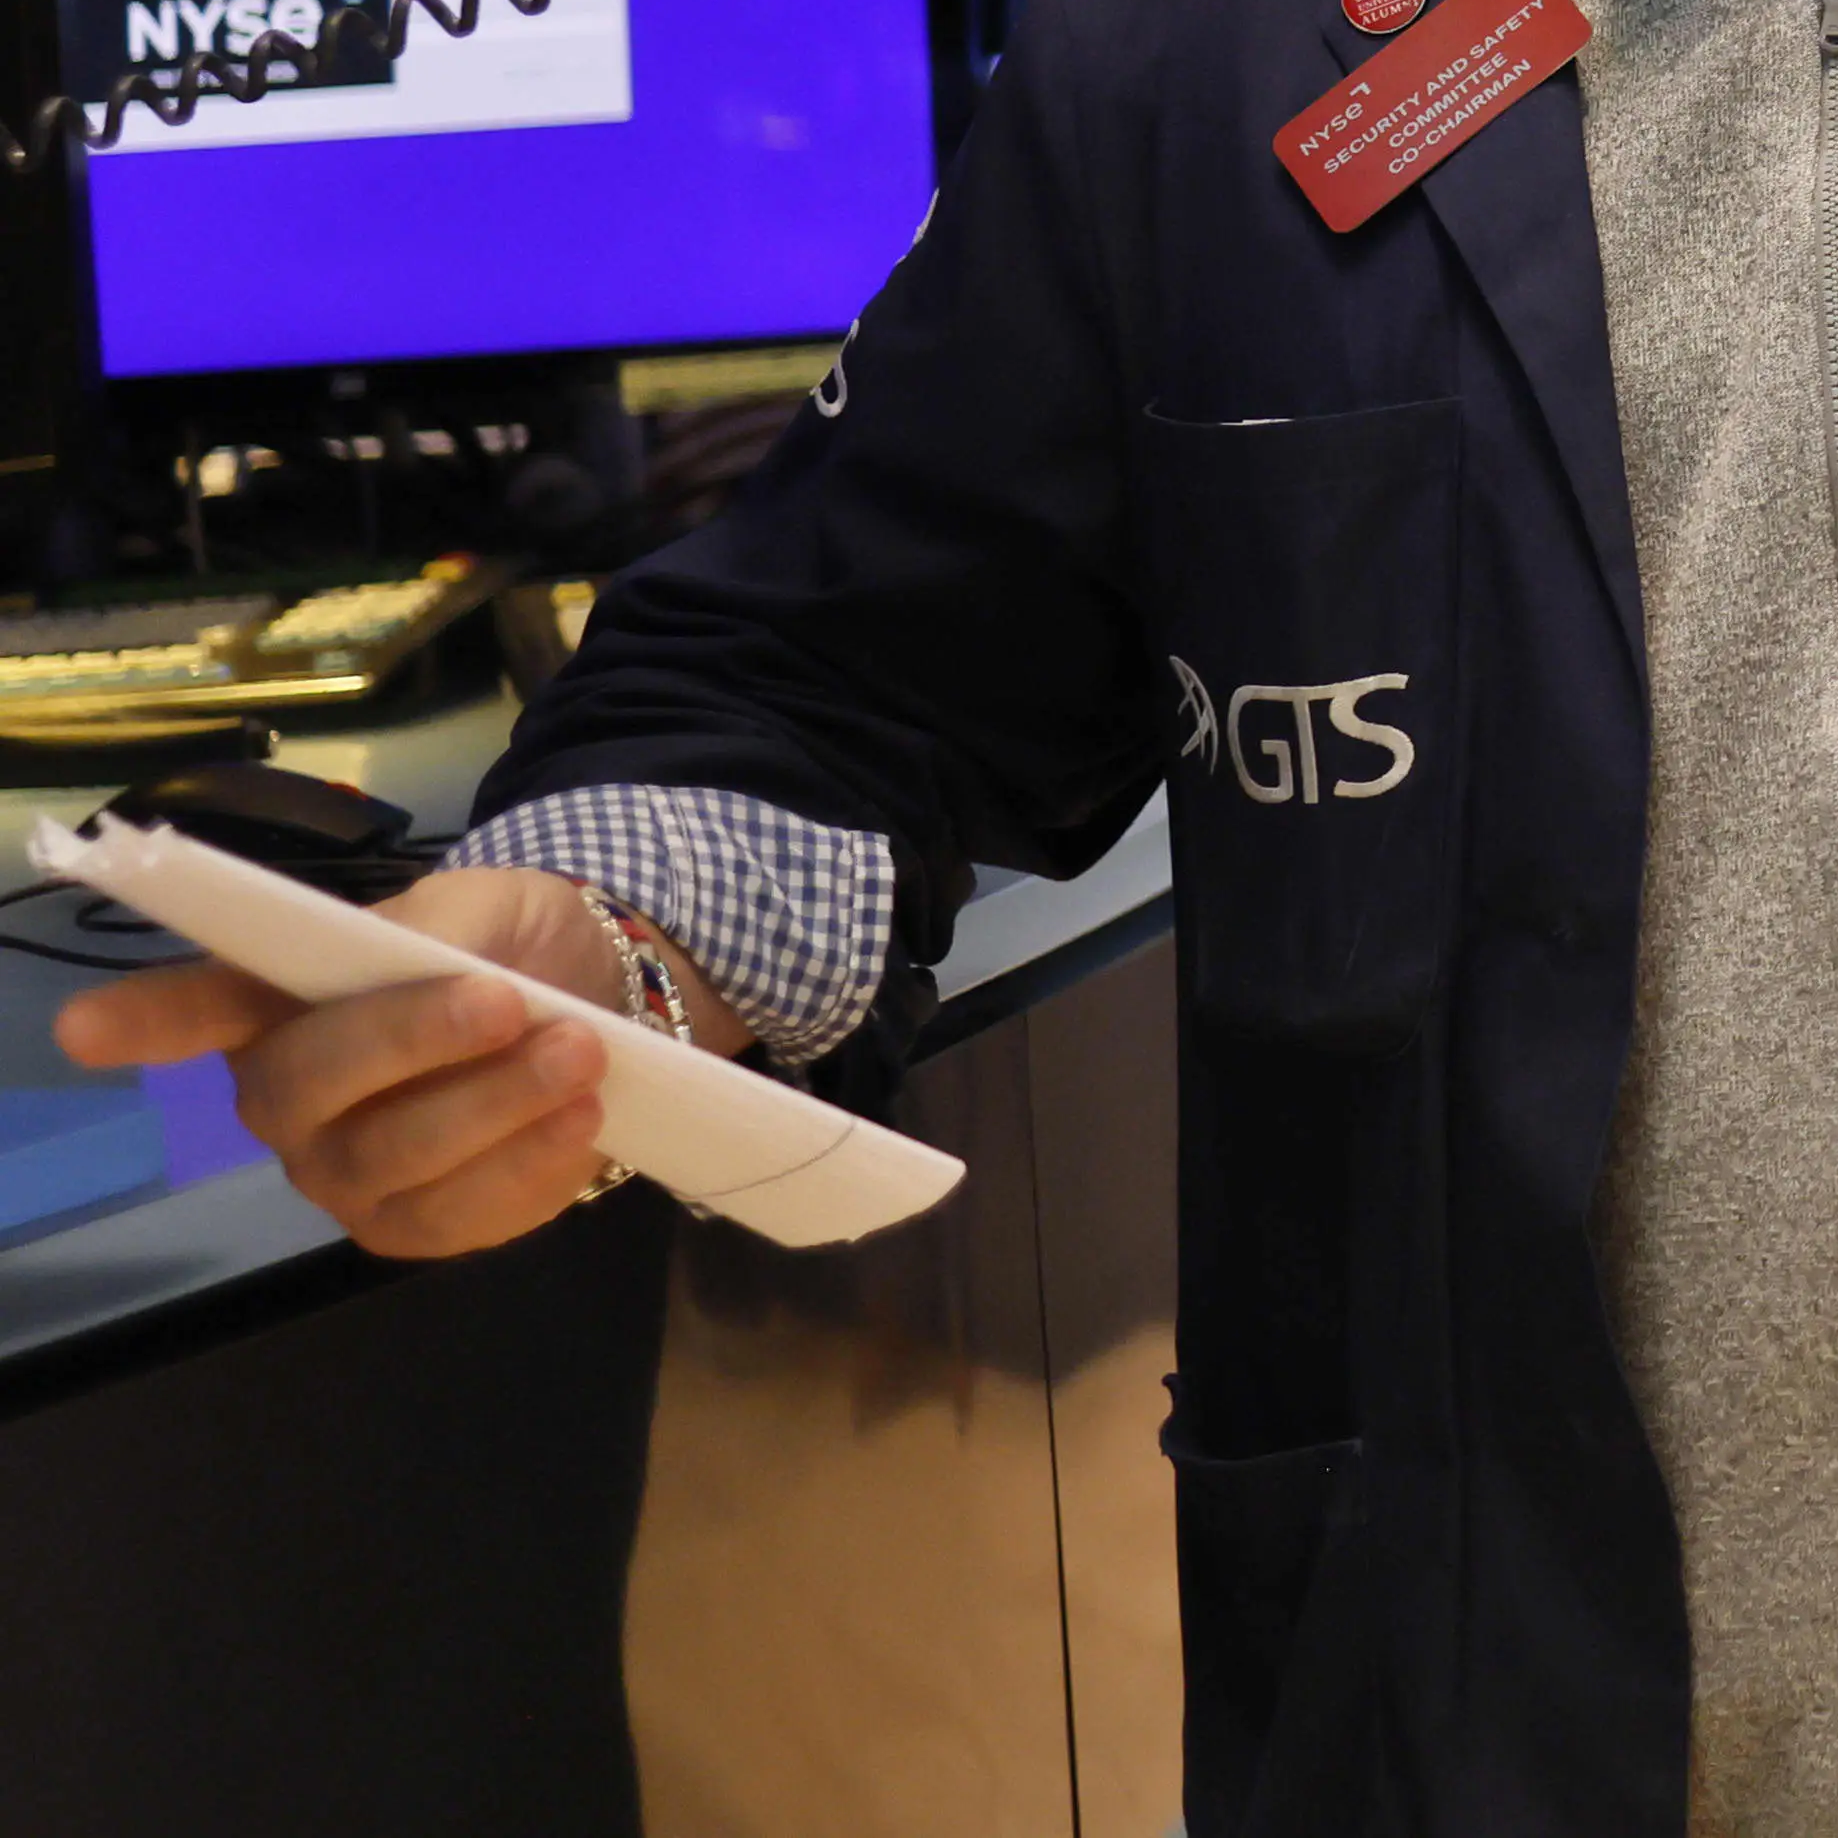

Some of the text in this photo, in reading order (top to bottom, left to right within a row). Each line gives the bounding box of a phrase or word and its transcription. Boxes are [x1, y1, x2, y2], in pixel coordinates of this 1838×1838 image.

[1324, 93, 1420, 174] SECURITY
[1426, 58, 1469, 96] AND
[1388, 59, 1532, 174] CO-CHAIRMAN
[1389, 52, 1508, 148] COMMITTEE
[1227, 673, 1415, 804] GTS
